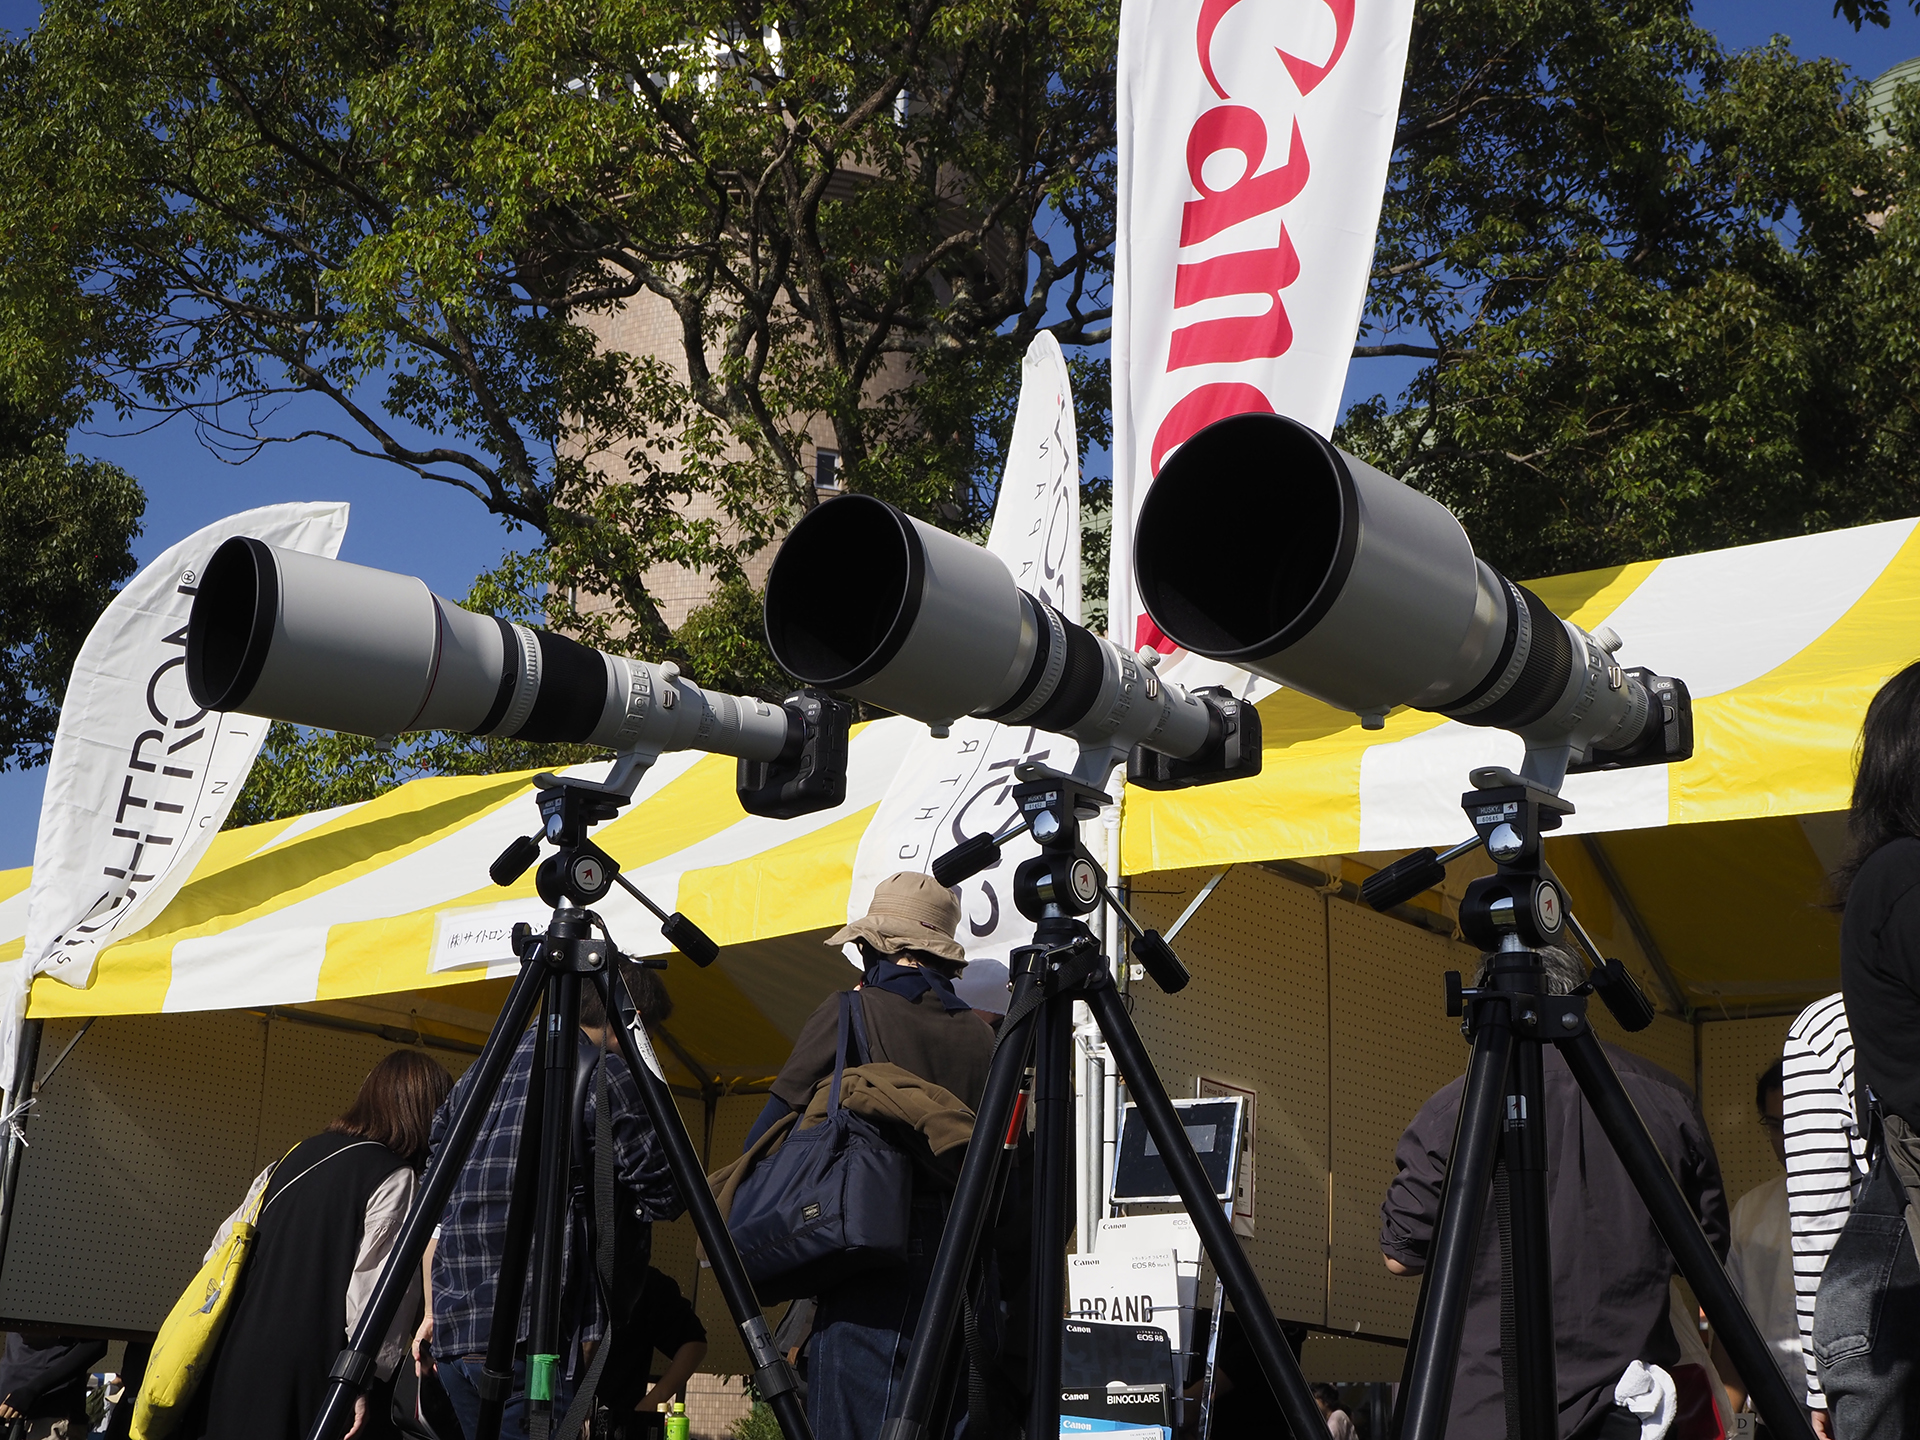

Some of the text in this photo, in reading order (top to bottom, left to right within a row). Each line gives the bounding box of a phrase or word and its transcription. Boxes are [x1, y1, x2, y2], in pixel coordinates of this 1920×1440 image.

[1480, 806, 1498, 814] HUSKY
[1073, 1259, 1100, 1267] Canon
[1132, 1261, 1147, 1270] EOS
[1066, 1324, 1091, 1333] Canon
[1136, 1333, 1164, 1342] EOS R8
[1061, 1393, 1089, 1401] Canon
[1106, 1394, 1160, 1404] BINOCULARS
[1063, 1420, 1092, 1431] Canon
